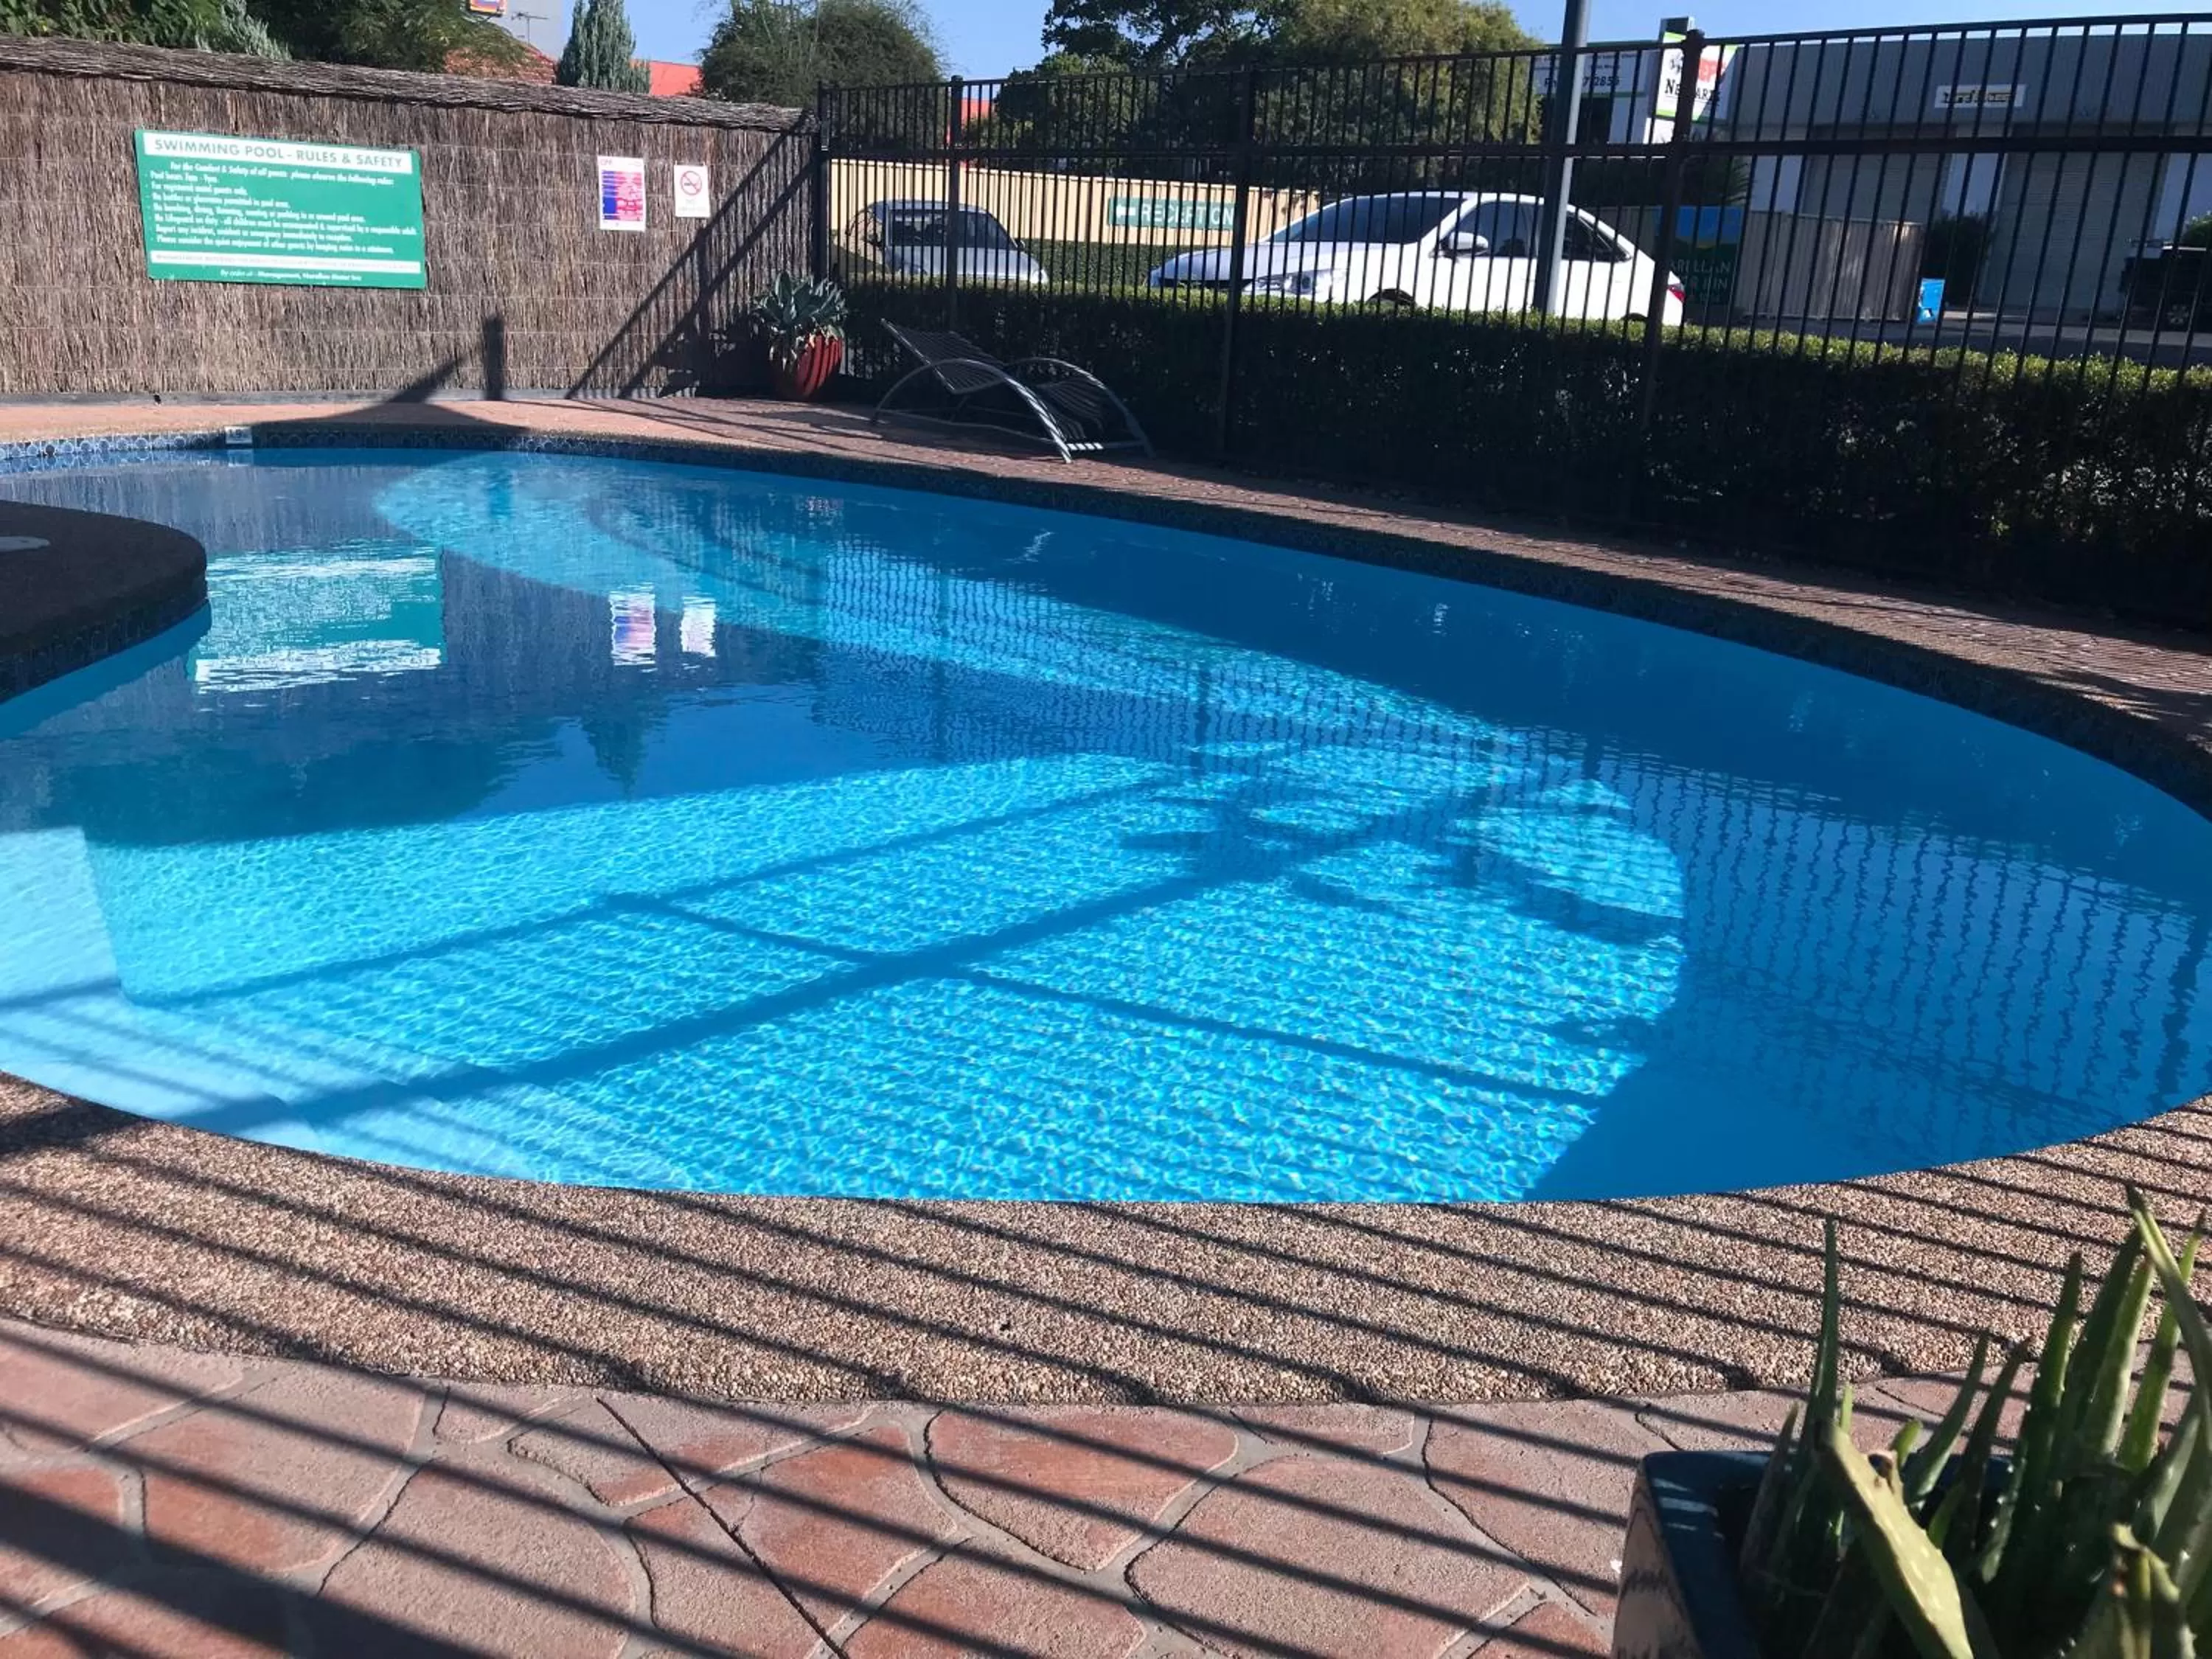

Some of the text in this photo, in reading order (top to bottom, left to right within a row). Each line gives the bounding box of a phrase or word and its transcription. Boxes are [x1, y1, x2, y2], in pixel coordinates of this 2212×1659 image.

[154, 138, 240, 156] SWIMMING
[245, 145, 284, 159] POOL
[296, 150, 337, 163] RULES
[341, 153, 351, 164] &
[356, 154, 403, 167] SAFETY
